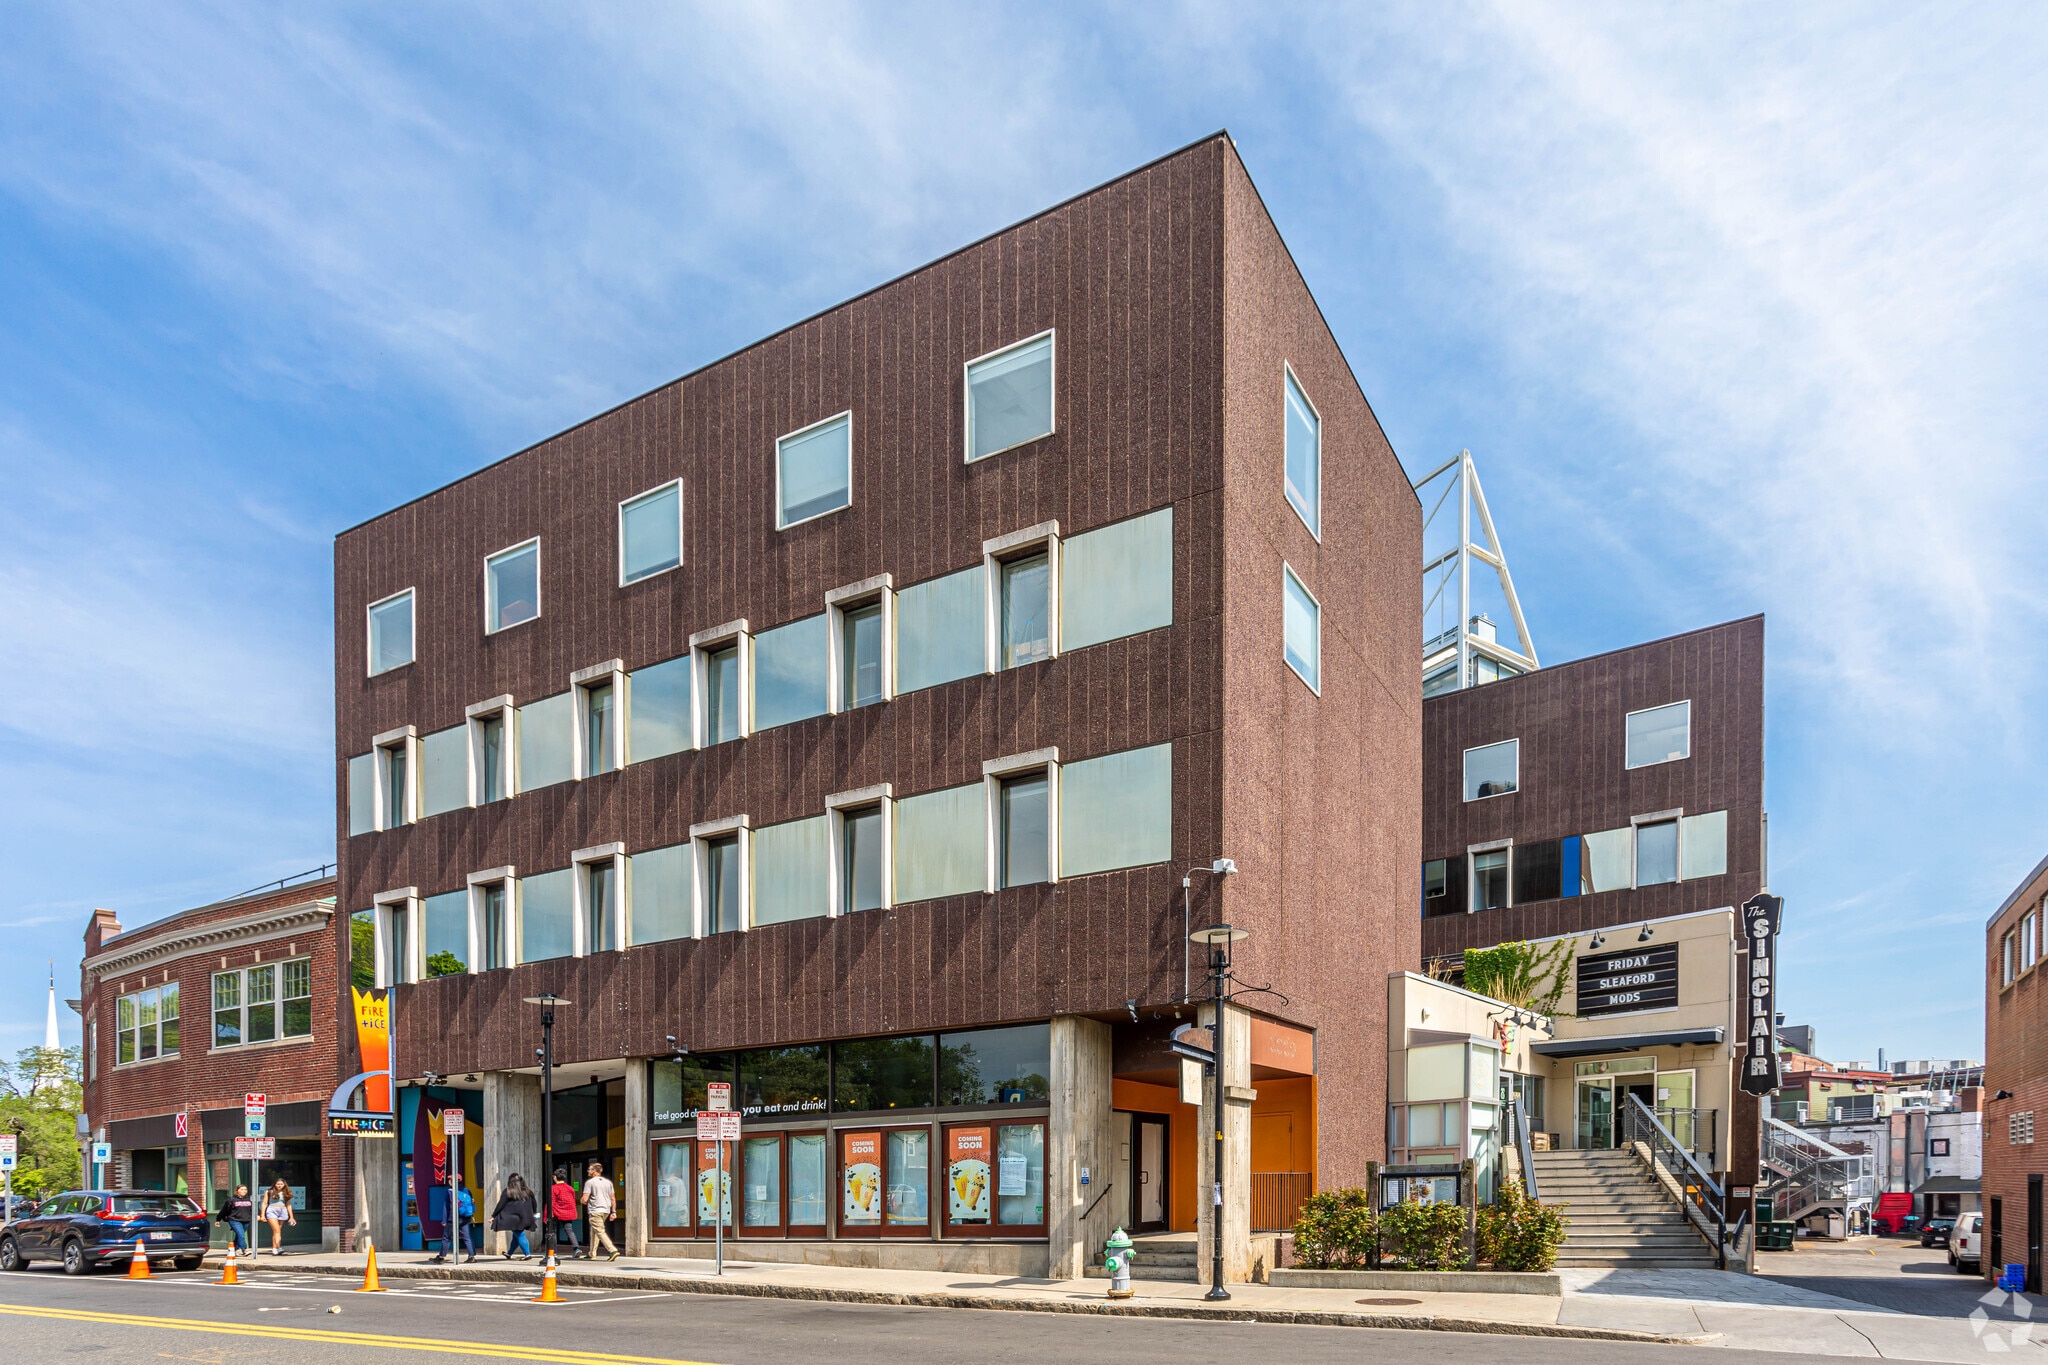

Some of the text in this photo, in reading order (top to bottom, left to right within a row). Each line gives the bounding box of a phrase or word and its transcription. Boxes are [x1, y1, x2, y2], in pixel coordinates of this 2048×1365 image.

[1747, 905, 1767, 918] The
[1607, 955, 1650, 971] FRIDAY
[1599, 973, 1656, 989] SLEAFORD
[1609, 992, 1641, 1005] MODS
[1750, 918, 1770, 1077] SINCLAIR
[654, 1110, 669, 1120] Feel
[670, 1108, 690, 1121] good
[742, 1105, 761, 1117] you
[764, 1103, 781, 1113] eat
[782, 1101, 800, 1112] and
[801, 1099, 827, 1111] drink!
[851, 1146, 875, 1154] SOON
[957, 1142, 983, 1150] SOON
